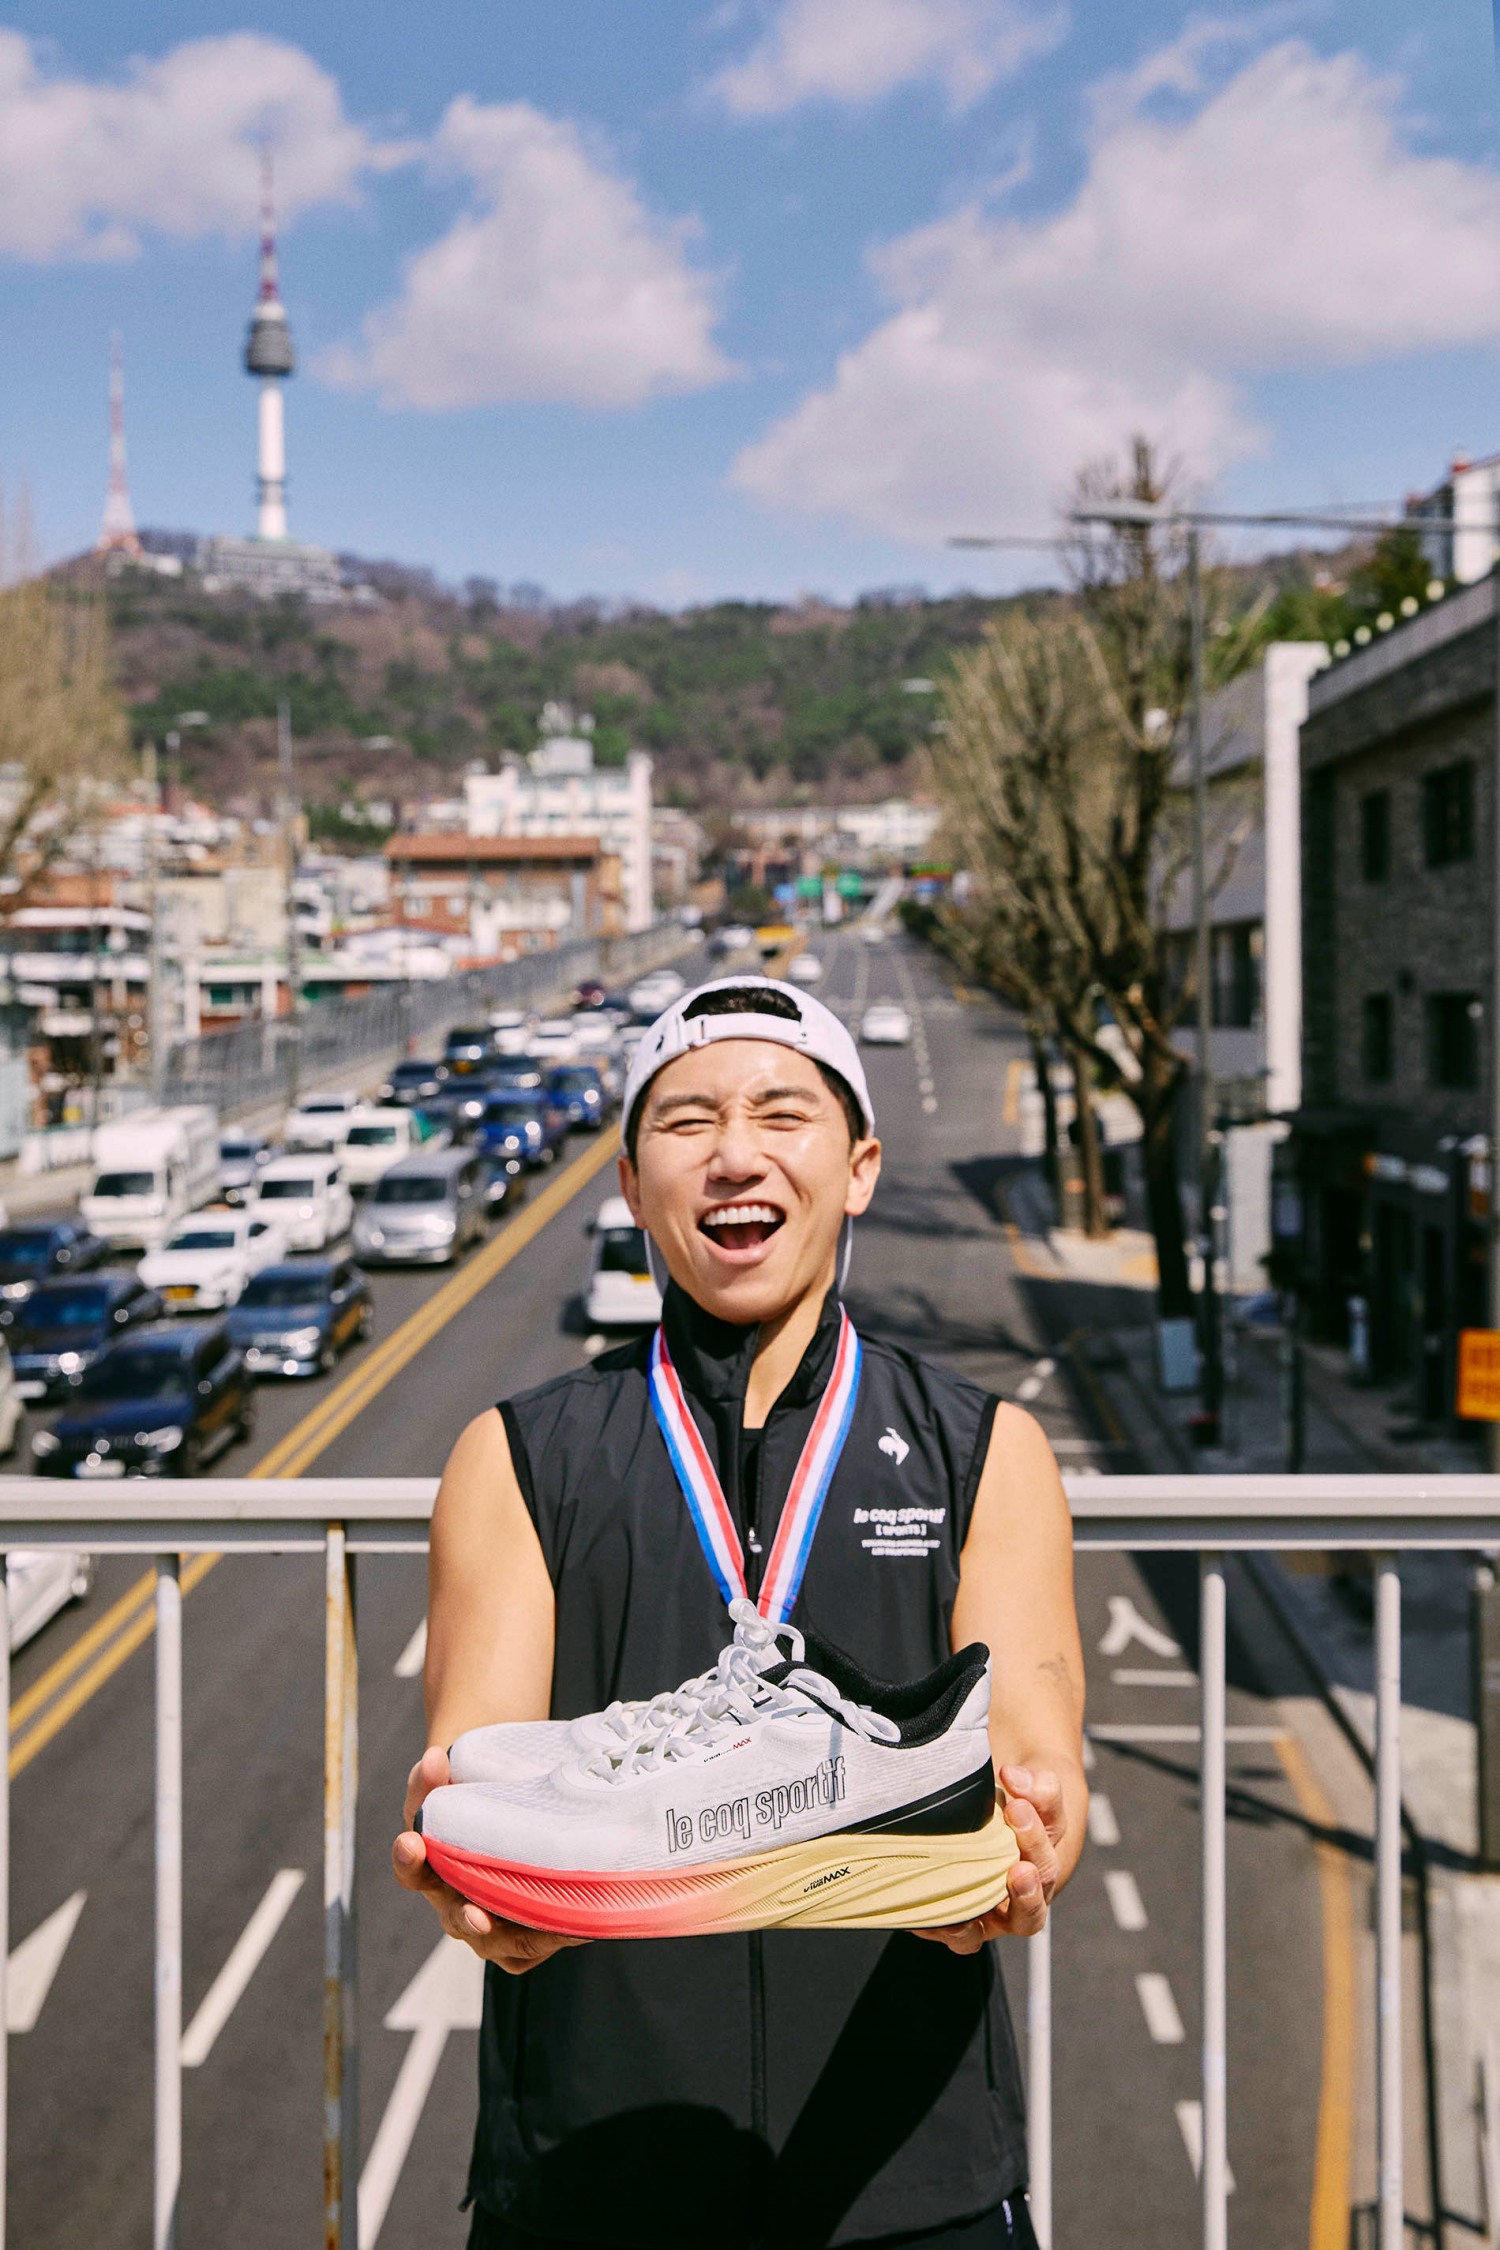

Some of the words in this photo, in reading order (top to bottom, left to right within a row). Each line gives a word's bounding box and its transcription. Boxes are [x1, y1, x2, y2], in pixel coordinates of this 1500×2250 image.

[869, 1508, 898, 1525] coq
[666, 1808, 693, 1853] le
[699, 1797, 750, 1842] coq
[755, 1755, 846, 1830] sportif
